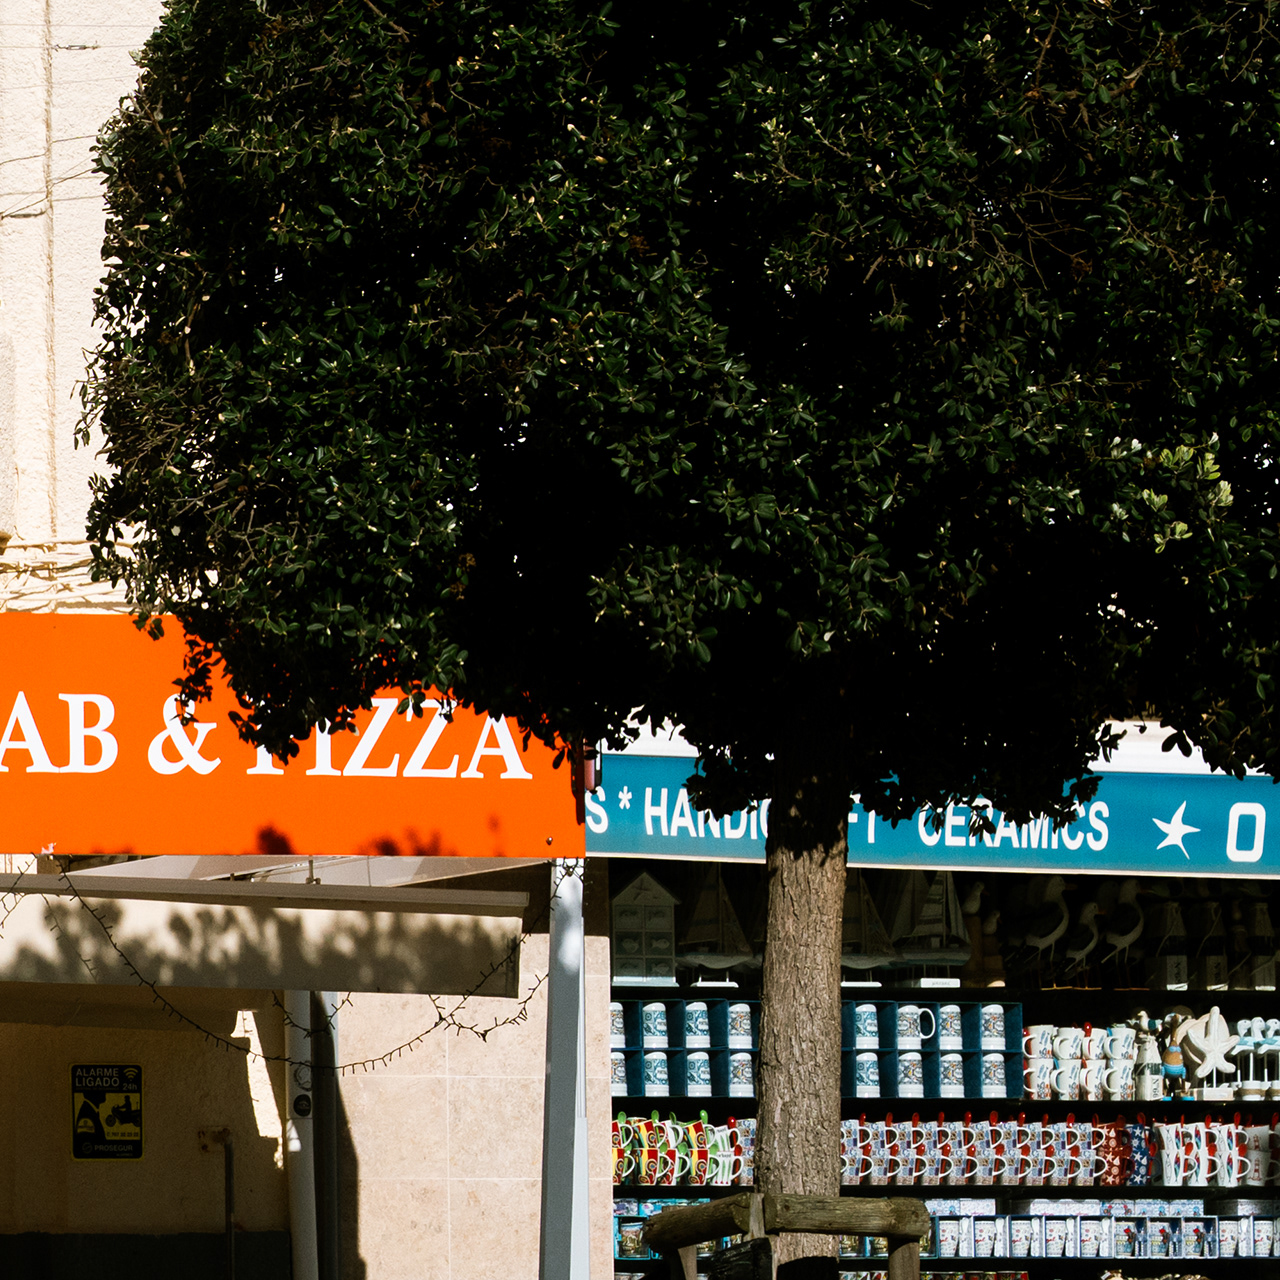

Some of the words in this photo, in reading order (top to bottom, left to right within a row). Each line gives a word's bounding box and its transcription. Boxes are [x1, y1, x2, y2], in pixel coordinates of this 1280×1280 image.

[147, 693, 221, 775] &
[644, 787, 880, 843] HANDIT
[918, 797, 1110, 851] CERAMICS
[75, 1068, 120, 1077] ALARME
[75, 1077, 120, 1087] LIGADO
[122, 1083, 138, 1091] 24h
[94, 1144, 133, 1152] PROSEGUR
